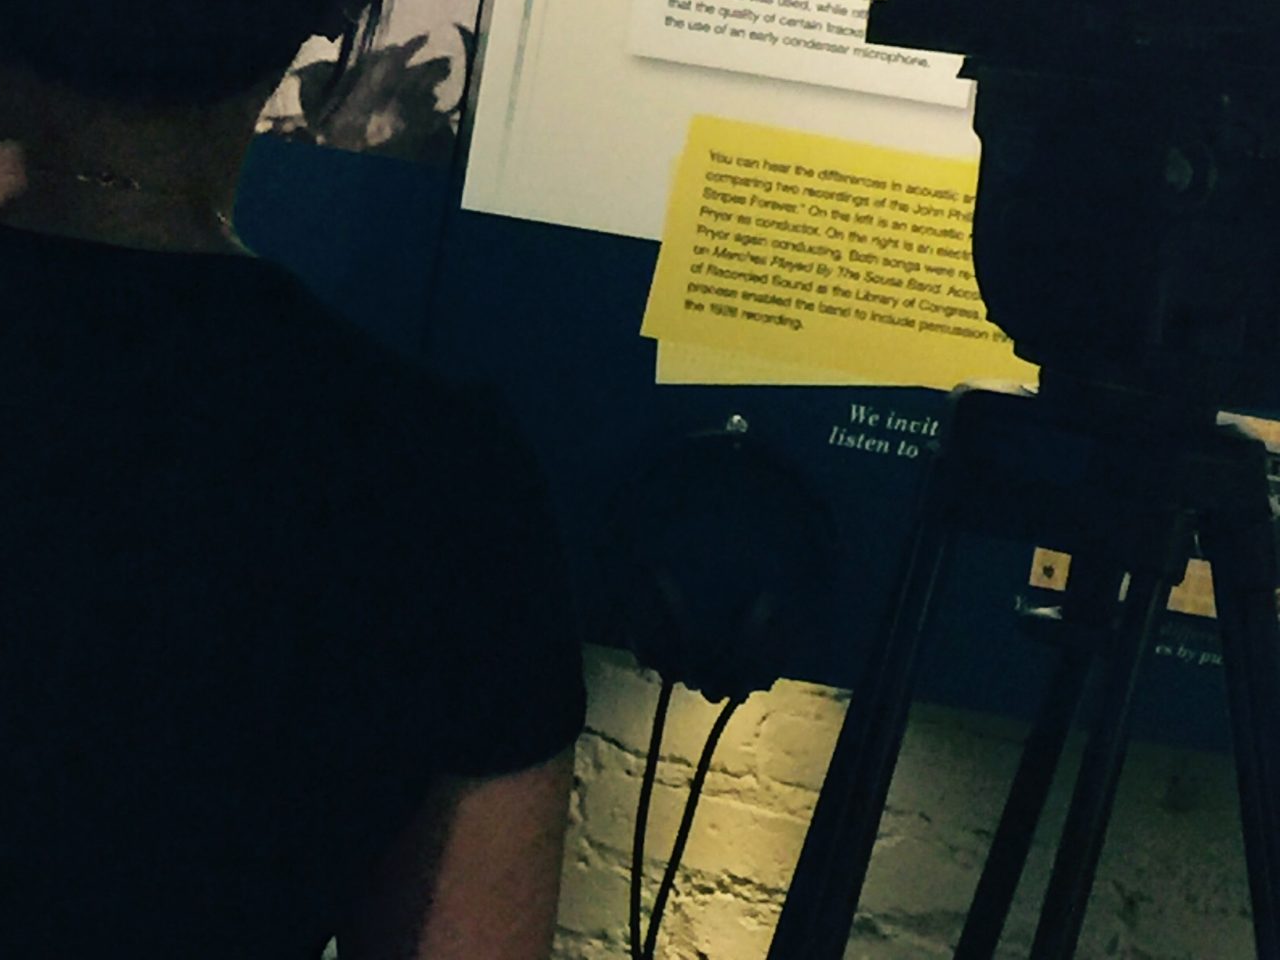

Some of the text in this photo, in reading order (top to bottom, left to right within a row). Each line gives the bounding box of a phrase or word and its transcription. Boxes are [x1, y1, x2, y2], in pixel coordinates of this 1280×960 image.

[850, 404, 880, 427] We
[828, 426, 919, 459] listen to
